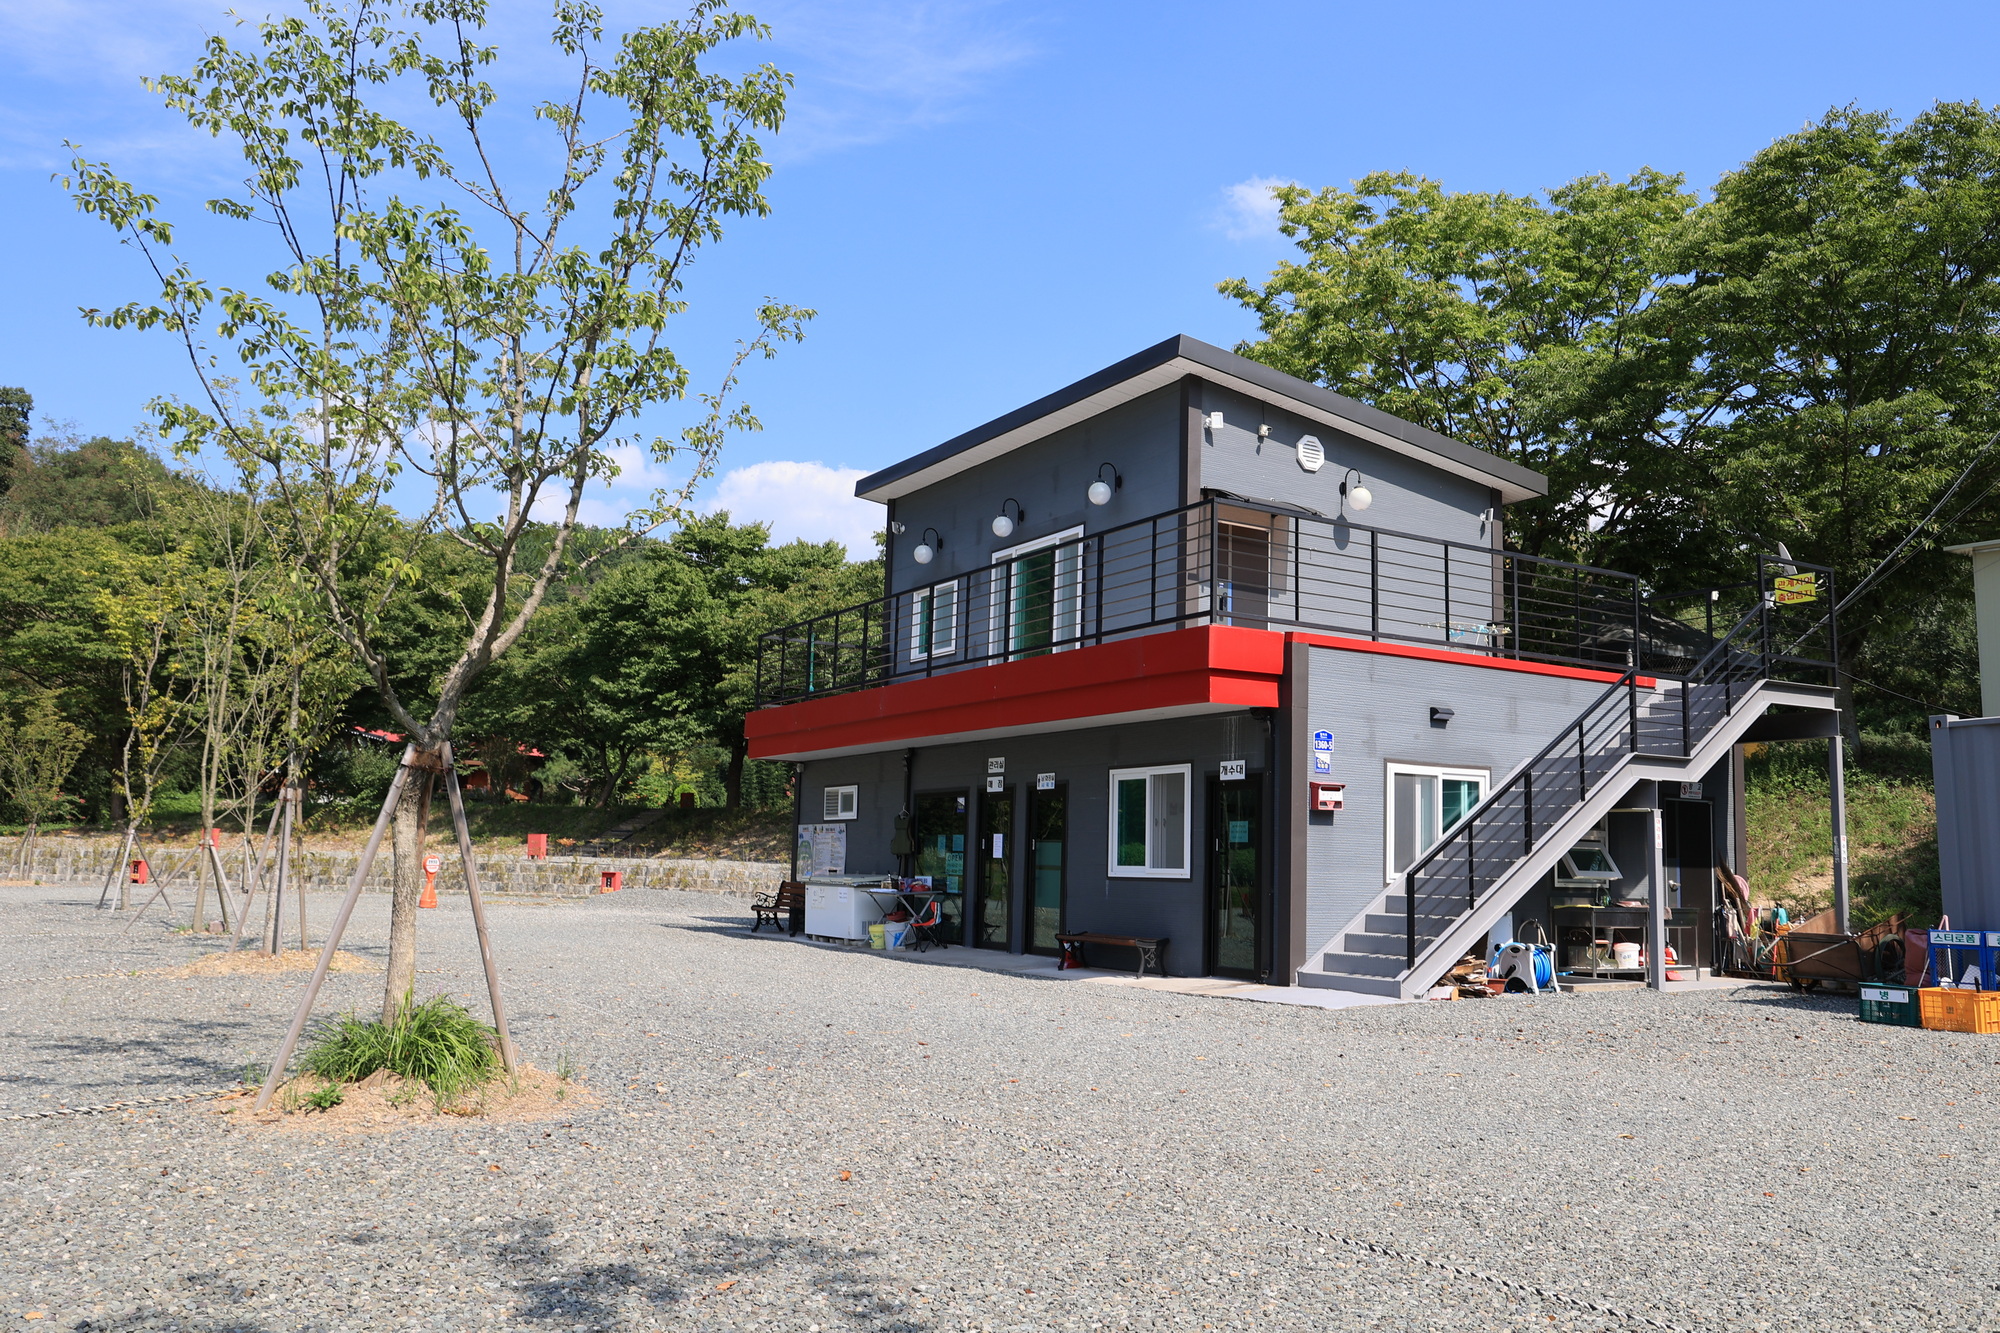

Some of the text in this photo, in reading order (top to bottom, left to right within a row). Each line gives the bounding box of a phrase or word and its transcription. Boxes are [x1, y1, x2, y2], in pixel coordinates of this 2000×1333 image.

[989, 760, 1004, 769] 관리실
[1220, 764, 1244, 776] 개수대
[1879, 990, 1889, 1000] 병
